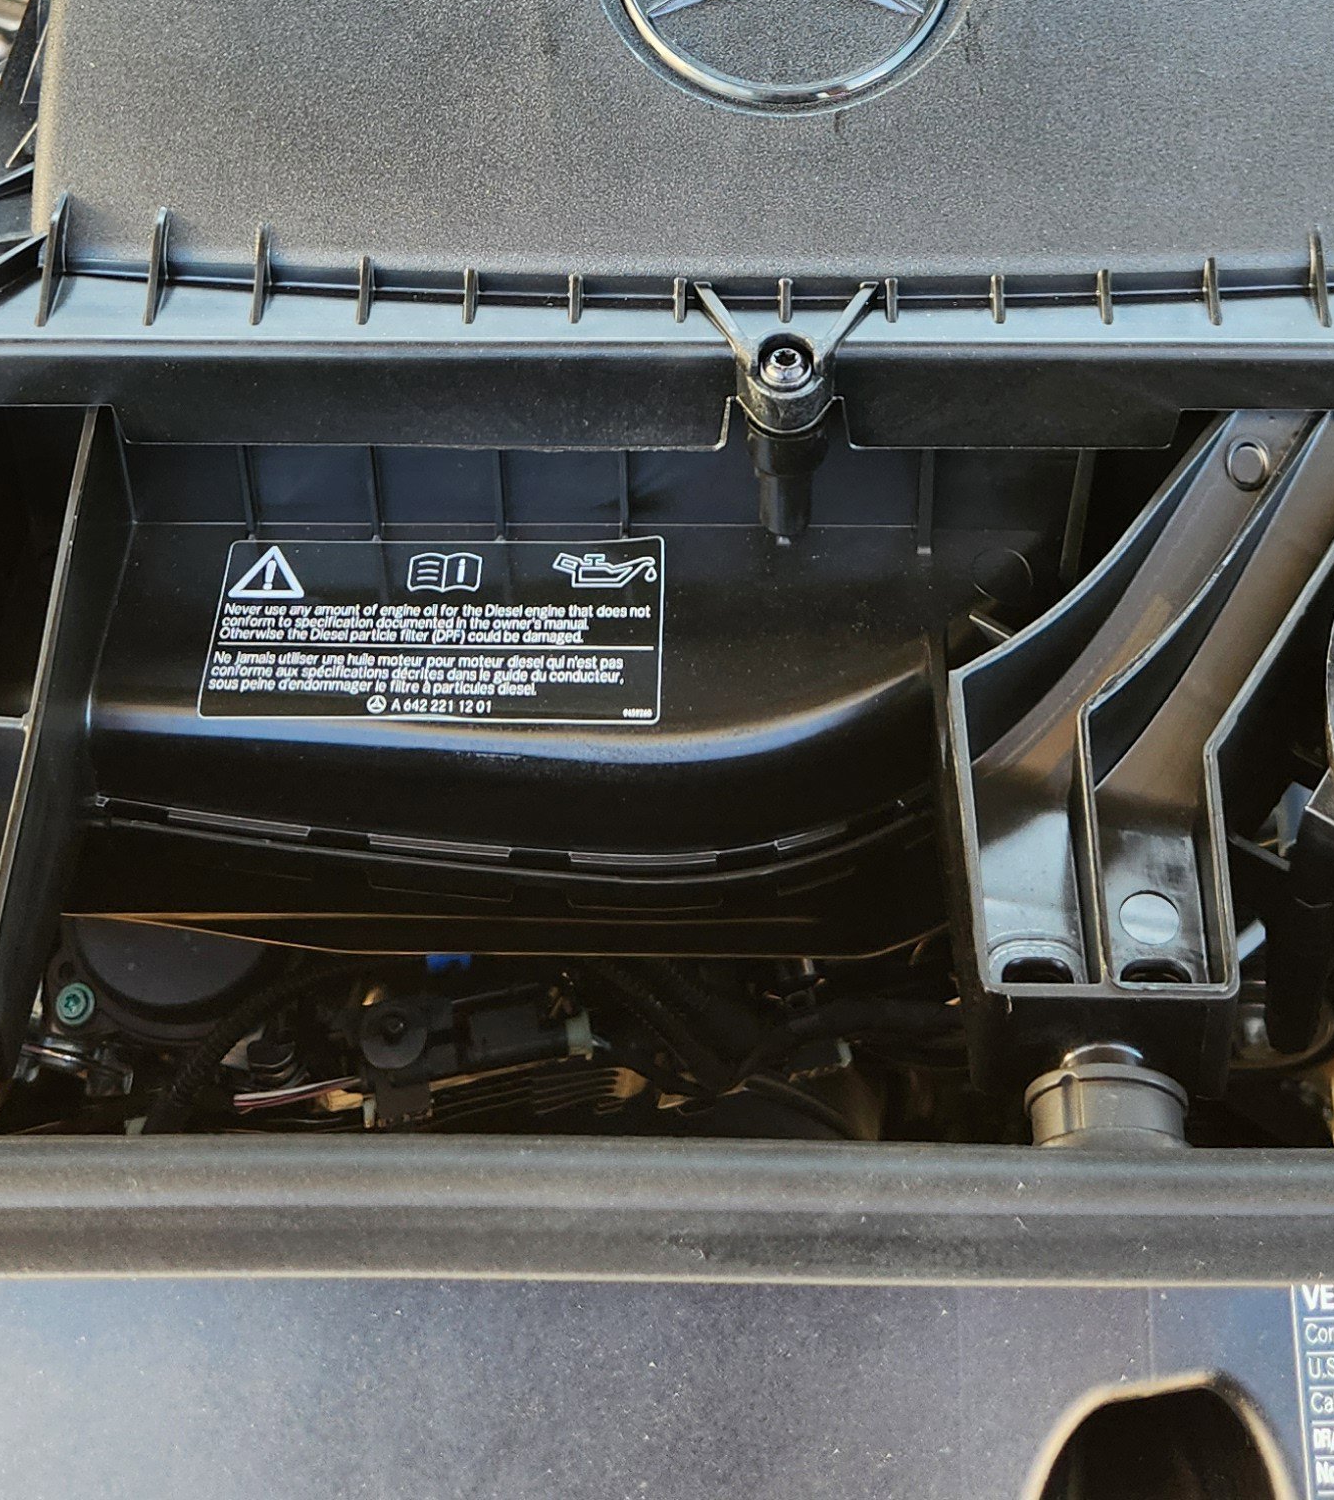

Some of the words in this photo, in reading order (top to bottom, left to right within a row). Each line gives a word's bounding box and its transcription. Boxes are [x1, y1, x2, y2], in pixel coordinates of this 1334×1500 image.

[224, 603, 261, 615] Never
[265, 606, 286, 616] use
[290, 606, 312, 618] any
[315, 604, 360, 616] amount
[363, 604, 378, 616] of
[380, 604, 420, 619] engine
[423, 604, 438, 616] oil
[441, 604, 459, 616] for
[462, 604, 482, 616] the
[485, 605, 522, 617] Diesel
[525, 605, 566, 620] engine
[569, 604, 593, 617] that
[596, 605, 627, 618] does
[630, 606, 651, 618] not
[222, 616, 275, 627] conform
[278, 617, 292, 627] to
[295, 616, 373, 630] specification
[376, 617, 455, 629] documented
[456, 618, 466, 629] in
[470, 618, 489, 630] the
[493, 618, 541, 630] owner's
[220, 628, 284, 640] Otherwise
[287, 628, 307, 640] the
[310, 629, 348, 641] Diesel
[349, 629, 396, 643] particle
[400, 629, 428, 642] filter
[432, 630, 465, 644] (DPF)
[468, 630, 501, 642] could
[504, 631, 520, 642] be
[522, 631, 584, 645] damaged.
[391, 700, 401, 712] A
[403, 700, 427, 712] 642
[430, 700, 453, 712] 221
[459, 700, 473, 713] 12
[476, 700, 491, 713] 01
